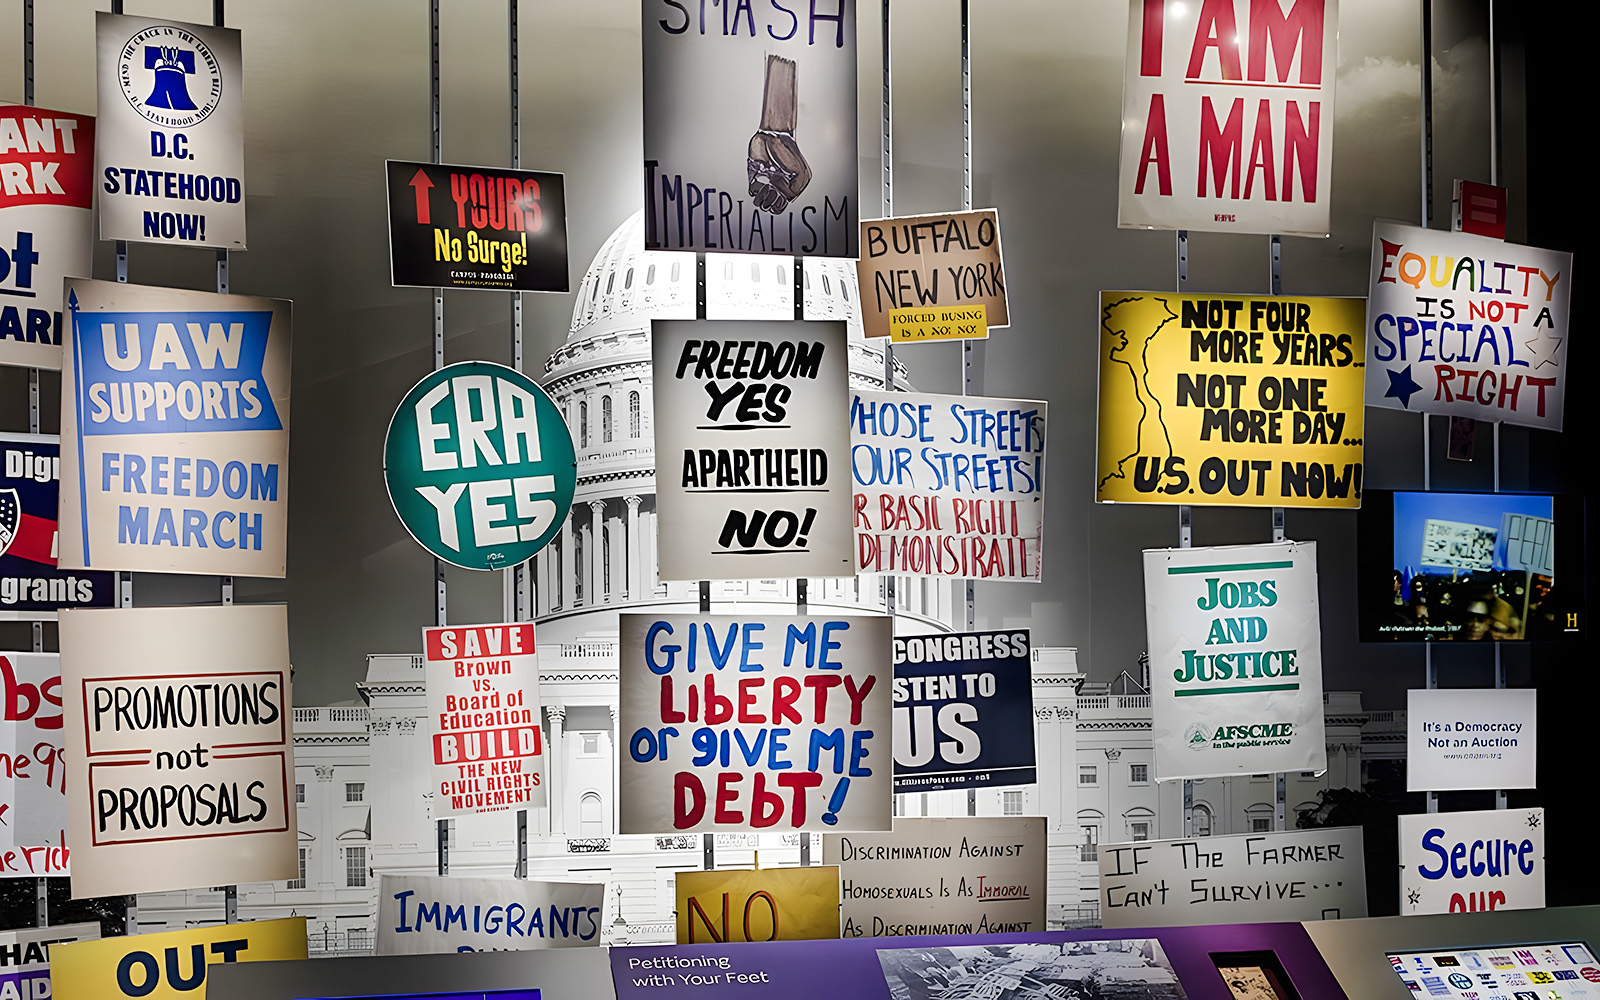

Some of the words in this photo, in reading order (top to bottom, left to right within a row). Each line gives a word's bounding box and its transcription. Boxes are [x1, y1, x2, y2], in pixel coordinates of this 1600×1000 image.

[1140, 0, 1164, 77] I
[1185, 0, 1325, 85] AM
[150, 131, 194, 160] D.C.
[1134, 93, 1173, 197] A
[1197, 96, 1321, 203] MAN
[104, 167, 241, 204] STATEHOOD
[450, 173, 543, 233] YOURS
[143, 211, 206, 241] NOW!
[644, 160, 849, 256] IMPERIALISM
[434, 228, 462, 263] No
[467, 230, 528, 273] Surge!
[867, 218, 995, 258] BUFFALO
[875, 268, 938, 313] NEW
[948, 261, 1006, 301] YORK
[1378, 237, 1560, 301] EQUALITY
[893, 314, 936, 324] FORCED
[942, 311, 982, 321] BUSING
[1181, 300, 1243, 329] NOT
[1250, 301, 1311, 333] FOUR
[1416, 297, 1455, 319] IS
[1469, 300, 1529, 323] NOT
[1533, 307, 1554, 328] A
[101, 322, 244, 372] UAW
[902, 329, 911, 337] IS
[917, 329, 925, 337] A
[1190, 330, 1263, 364] MORE
[1374, 313, 1529, 367] SPECIAL
[675, 340, 825, 380] FREEDOM
[89, 379, 262, 423] SUPPORTS
[704, 380, 792, 423] YES
[1176, 373, 1246, 408] NOT
[1258, 376, 1327, 412] ONE
[1433, 364, 1556, 417] RIGHT
[415, 375, 542, 472] ERA
[851, 395, 934, 442] HOSE
[950, 404, 1044, 453] STREETS
[1200, 409, 1282, 443] MORE
[102, 452, 278, 502] FREEDOM
[682, 448, 828, 488] APARTHEID
[852, 444, 915, 489] OUR
[1133, 456, 1194, 495] U.S.
[1199, 457, 1272, 496] OUT
[1280, 462, 1362, 499] NOW!
[118, 505, 262, 551] MARCH
[414, 474, 557, 553] YES
[718, 507, 817, 549] NO!
[879, 495, 944, 531] BASIC
[952, 498, 1025, 537] RIGHT
[858, 533, 1035, 578] DEMONSTRATE
[1, 576, 93, 604] grants
[1205, 616, 1268, 645] AND
[1567, 613, 1577, 627] H
[440, 627, 523, 659] SAVE
[645, 621, 765, 675] GIVE
[784, 621, 850, 670] ME
[893, 633, 1028, 664] CONGRESS
[454, 660, 511, 678] Brown
[962, 673, 996, 698] TO
[1173, 649, 1299, 682] JUSTICE
[94, 681, 280, 732] PROMOTIONS
[440, 709, 532, 730] Education
[446, 692, 500, 712] Board
[508, 690, 523, 707] of
[440, 728, 535, 763] BUILD
[893, 703, 981, 767] US
[1211, 723, 1293, 741] AFSCME
[1423, 722, 1441, 732] It's
[1445, 724, 1451, 732] a
[1455, 722, 1522, 734] Democracy
[1428, 738, 1449, 748] Not
[1471, 737, 1518, 747] Auction
[156, 742, 209, 770] not
[458, 763, 485, 779] THE
[491, 760, 521, 776] NEW
[629, 727, 679, 762] or
[808, 728, 874, 777] ME
[441, 779, 481, 795] CIVIL
[487, 773, 540, 790] RIGHTS
[452, 788, 532, 809] MOVEMENT
[98, 780, 268, 833] PROPOSALS
[1105, 846, 1152, 876] IF
[1418, 829, 1534, 880] Secure
[393, 890, 601, 941] IMMIGRANTS
[687, 890, 779, 944] NO
[629, 955, 731, 971] Petitioning
[633, 974, 675, 987] with
[679, 973, 721, 986] Your
[726, 971, 769, 985] Feet
